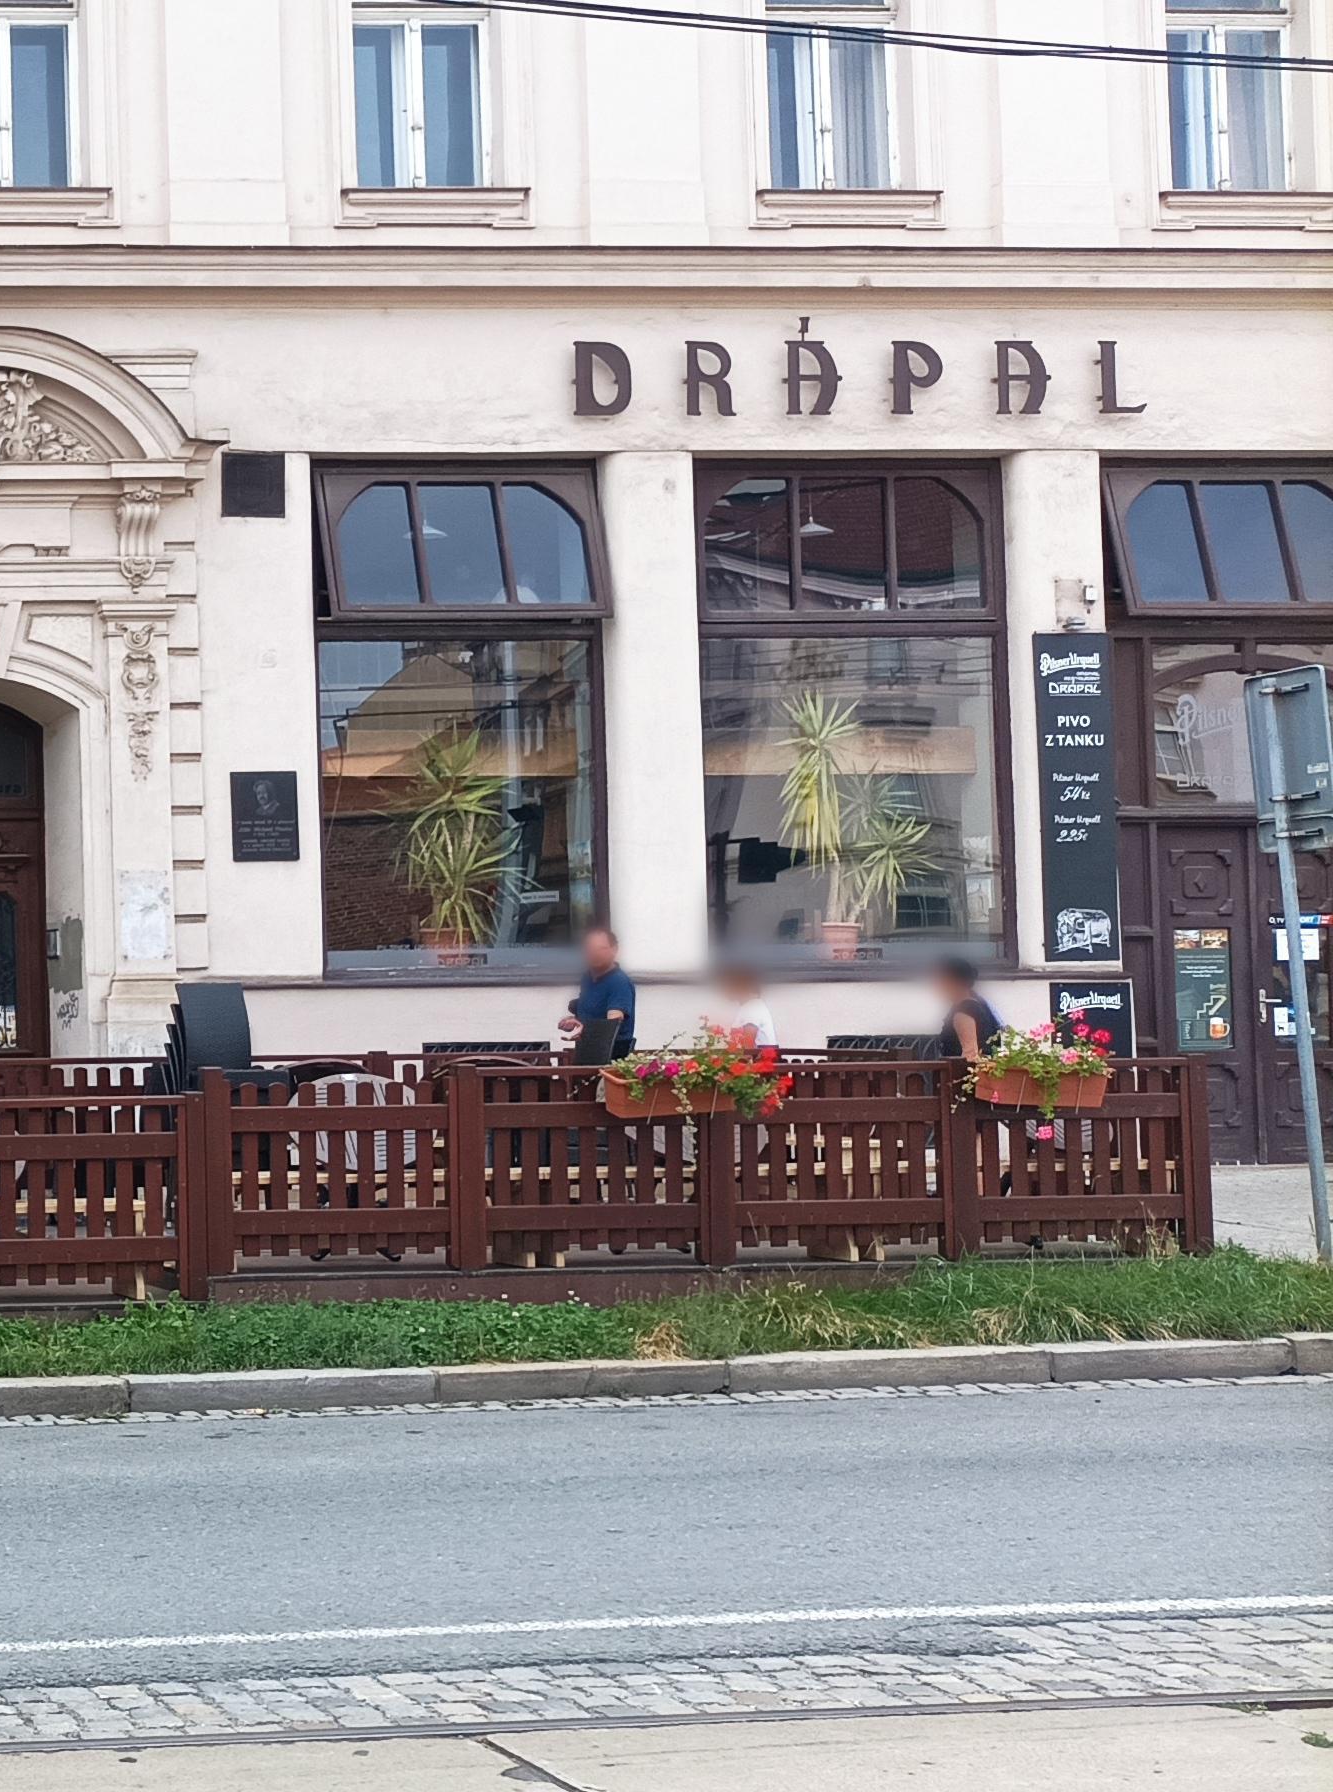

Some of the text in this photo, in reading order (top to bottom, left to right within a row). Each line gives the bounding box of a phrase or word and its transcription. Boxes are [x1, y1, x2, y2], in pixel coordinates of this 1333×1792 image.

[573, 316, 1148, 416] DRÁPAL
[1039, 653, 1070, 676] Pilsner
[1069, 652, 1100, 669] Urquell
[1057, 715, 1091, 727] PIVO
[1044, 734, 1104, 746] Z TANKU
[1059, 990, 1122, 1015] Pilsner Urquell
